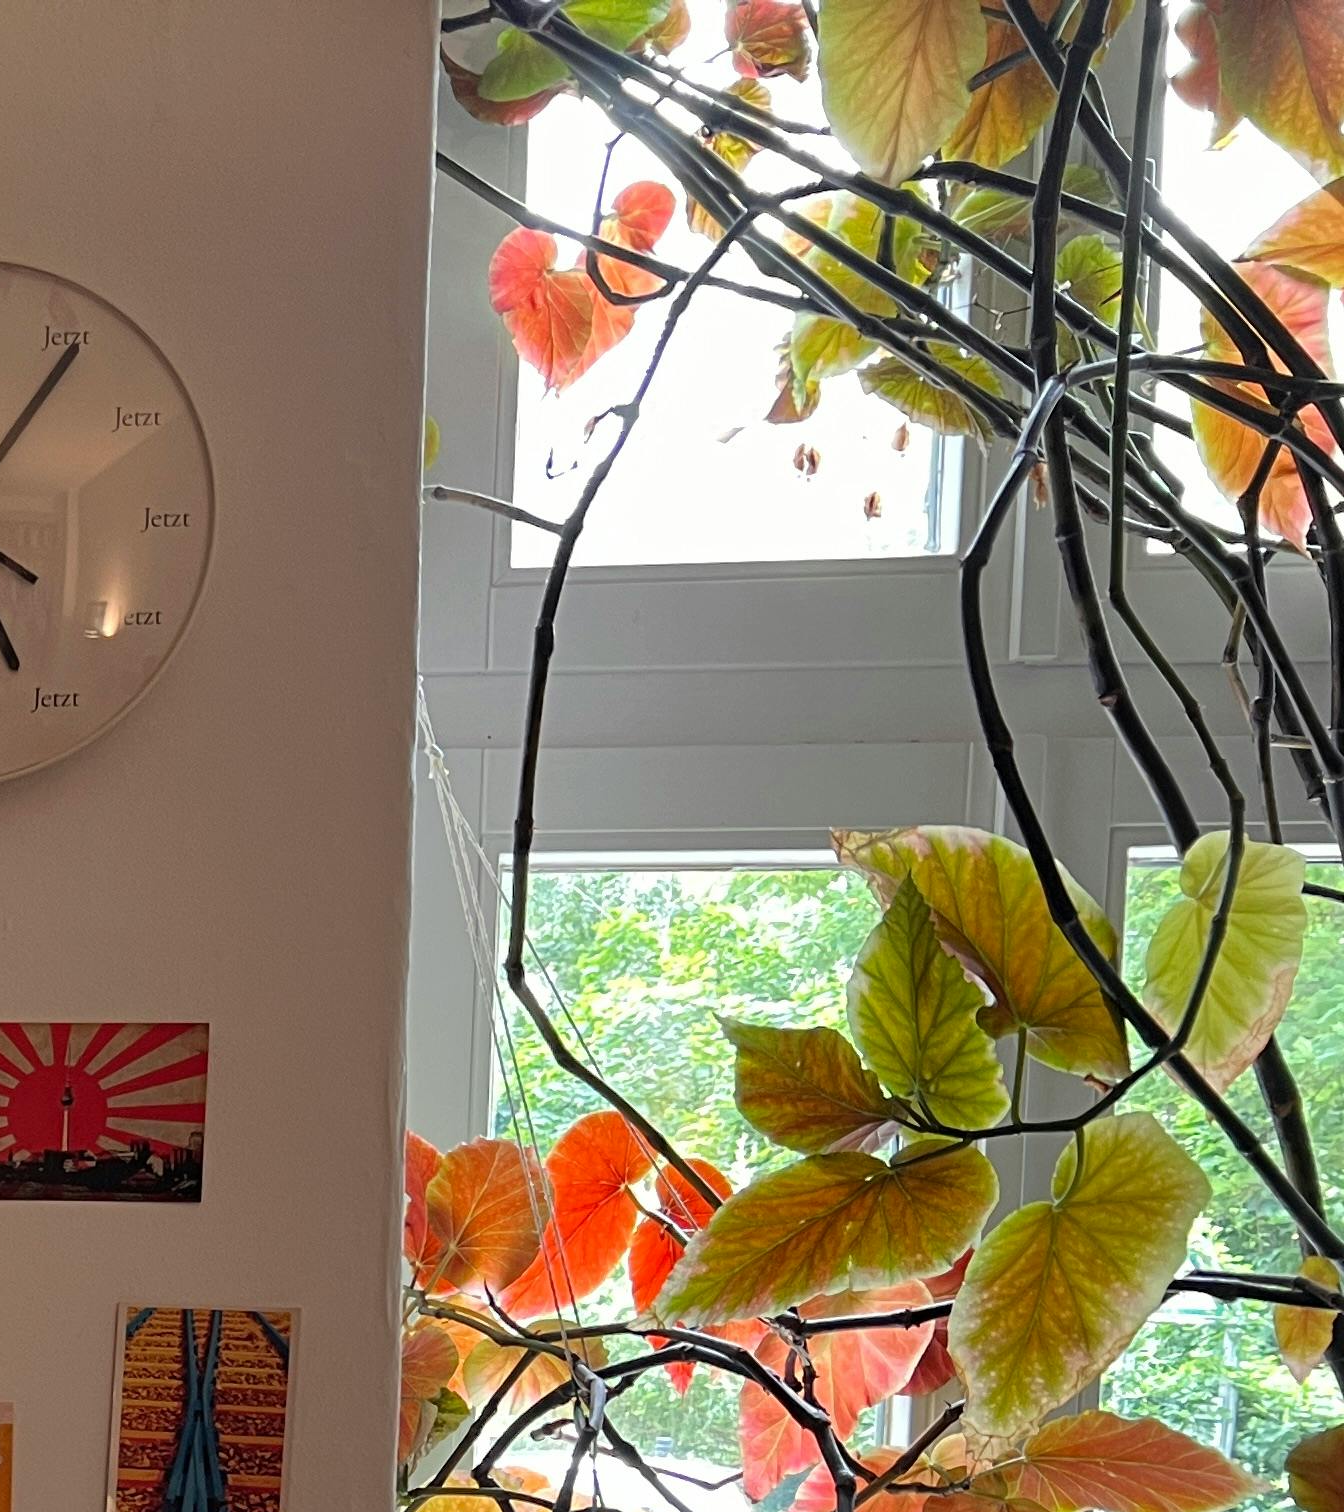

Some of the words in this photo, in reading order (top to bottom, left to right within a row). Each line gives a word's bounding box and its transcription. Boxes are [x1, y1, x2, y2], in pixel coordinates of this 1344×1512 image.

[41, 326, 89, 349] Jetzt
[112, 407, 161, 433] Jetzt
[141, 507, 190, 532] Jetzt
[119, 609, 162, 628] etzt
[31, 687, 79, 712] Jetzt
